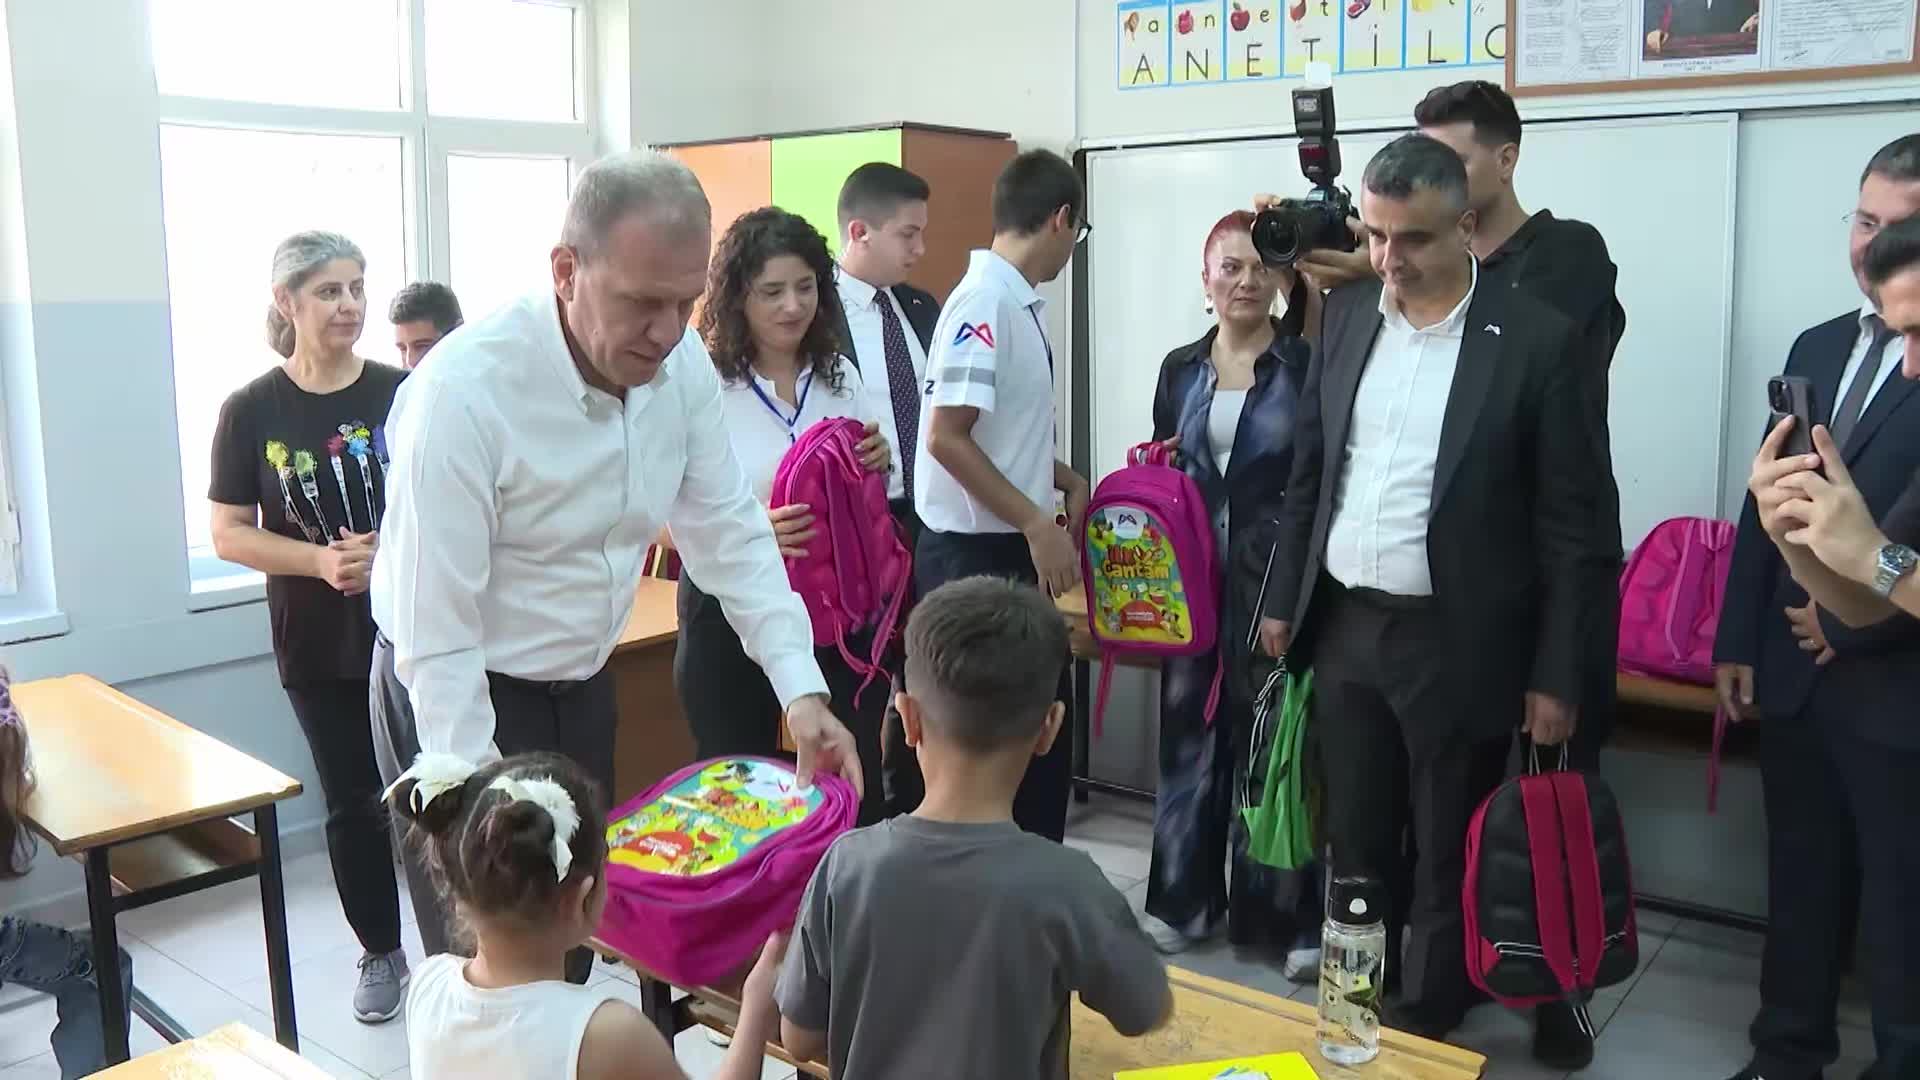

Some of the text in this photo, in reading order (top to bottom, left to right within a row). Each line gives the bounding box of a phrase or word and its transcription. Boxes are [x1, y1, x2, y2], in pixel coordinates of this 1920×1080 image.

[1148, 20, 1159, 33] a
[1205, 13, 1215, 28] n
[1259, 9, 1270, 23] e
[1132, 53, 1154, 84] A
[1186, 48, 1209, 80] N
[1246, 43, 1263, 77] E
[1301, 38, 1321, 62] T
[1428, 29, 1447, 64] L
